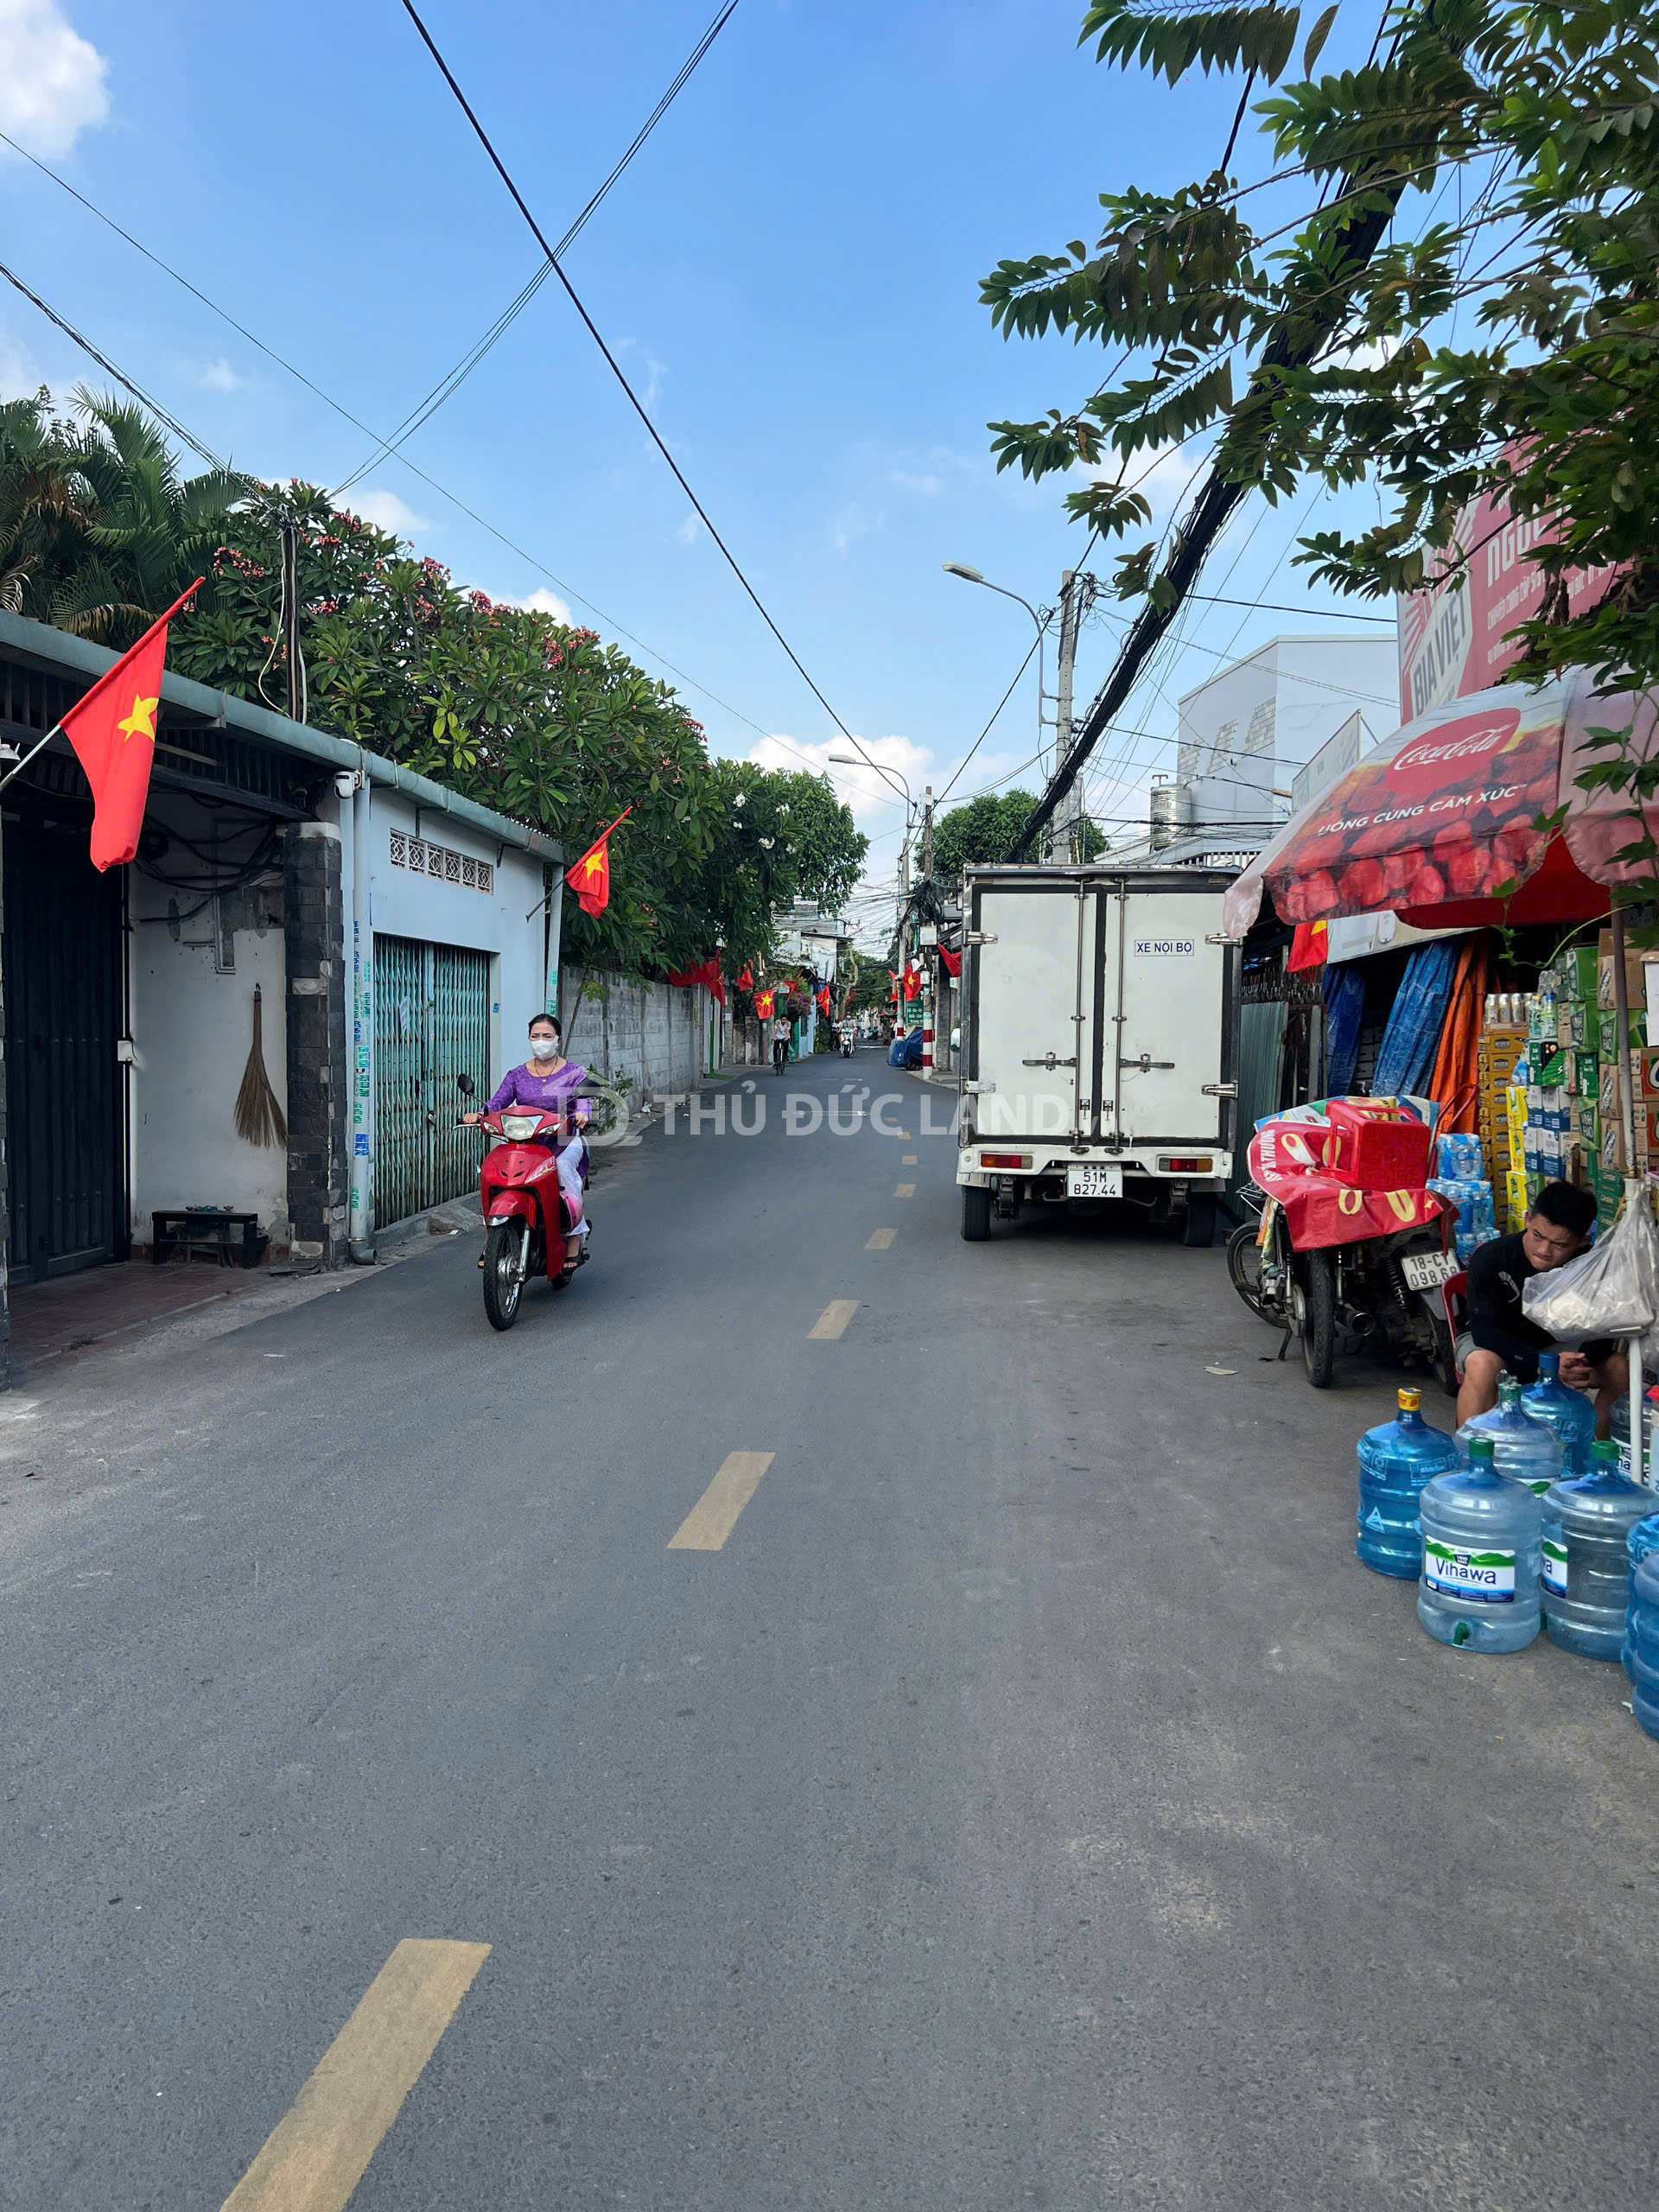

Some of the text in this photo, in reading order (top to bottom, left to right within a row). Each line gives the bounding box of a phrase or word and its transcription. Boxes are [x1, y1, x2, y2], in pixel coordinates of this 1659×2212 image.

[1413, 640, 1437, 717] BIA
[1136, 943, 1151, 952] XE
[1084, 1172, 1107, 1183] 51M
[1074, 1184, 1116, 1196] 827.44
[1435, 1557, 1497, 1585] Vihawa
